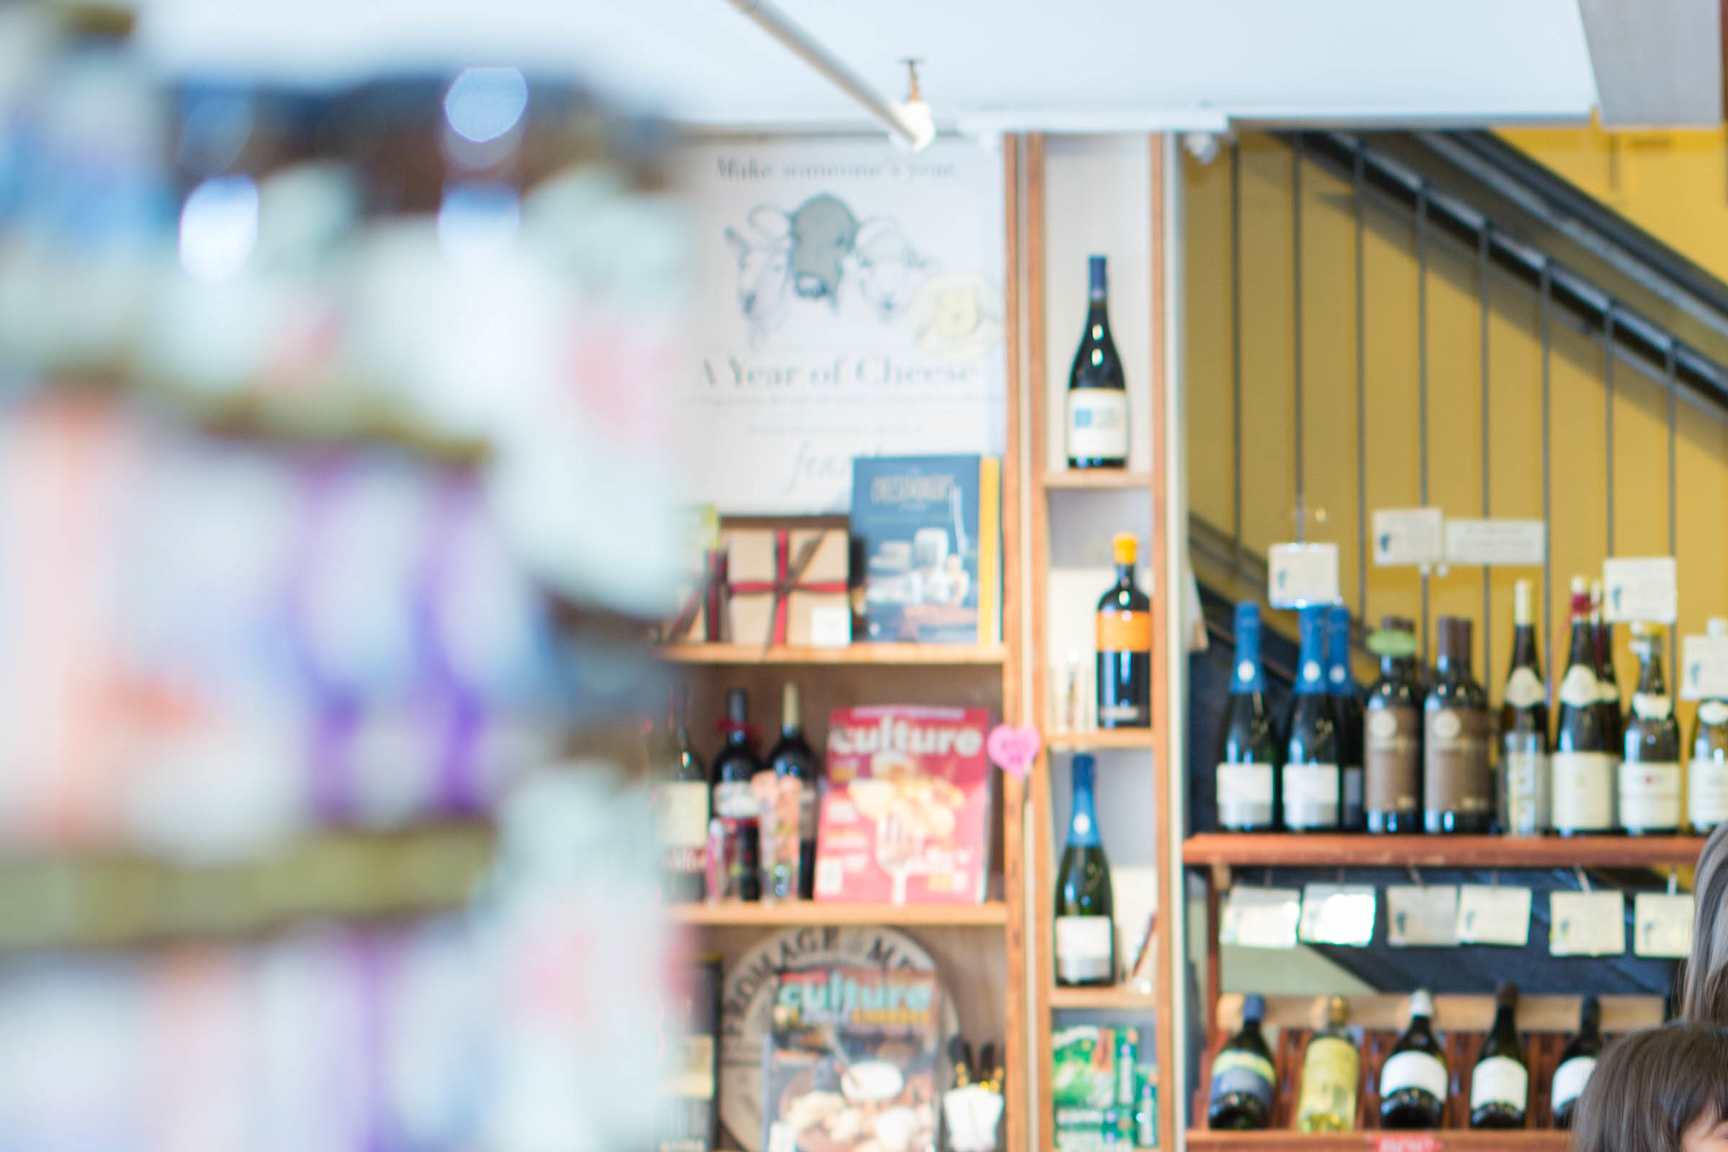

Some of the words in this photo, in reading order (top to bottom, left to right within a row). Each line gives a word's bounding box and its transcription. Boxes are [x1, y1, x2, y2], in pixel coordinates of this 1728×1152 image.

[727, 354, 800, 386] Year
[810, 354, 843, 385] of
[854, 353, 973, 385] Cheese
[825, 716, 983, 757] culture
[780, 969, 933, 1010] culture
